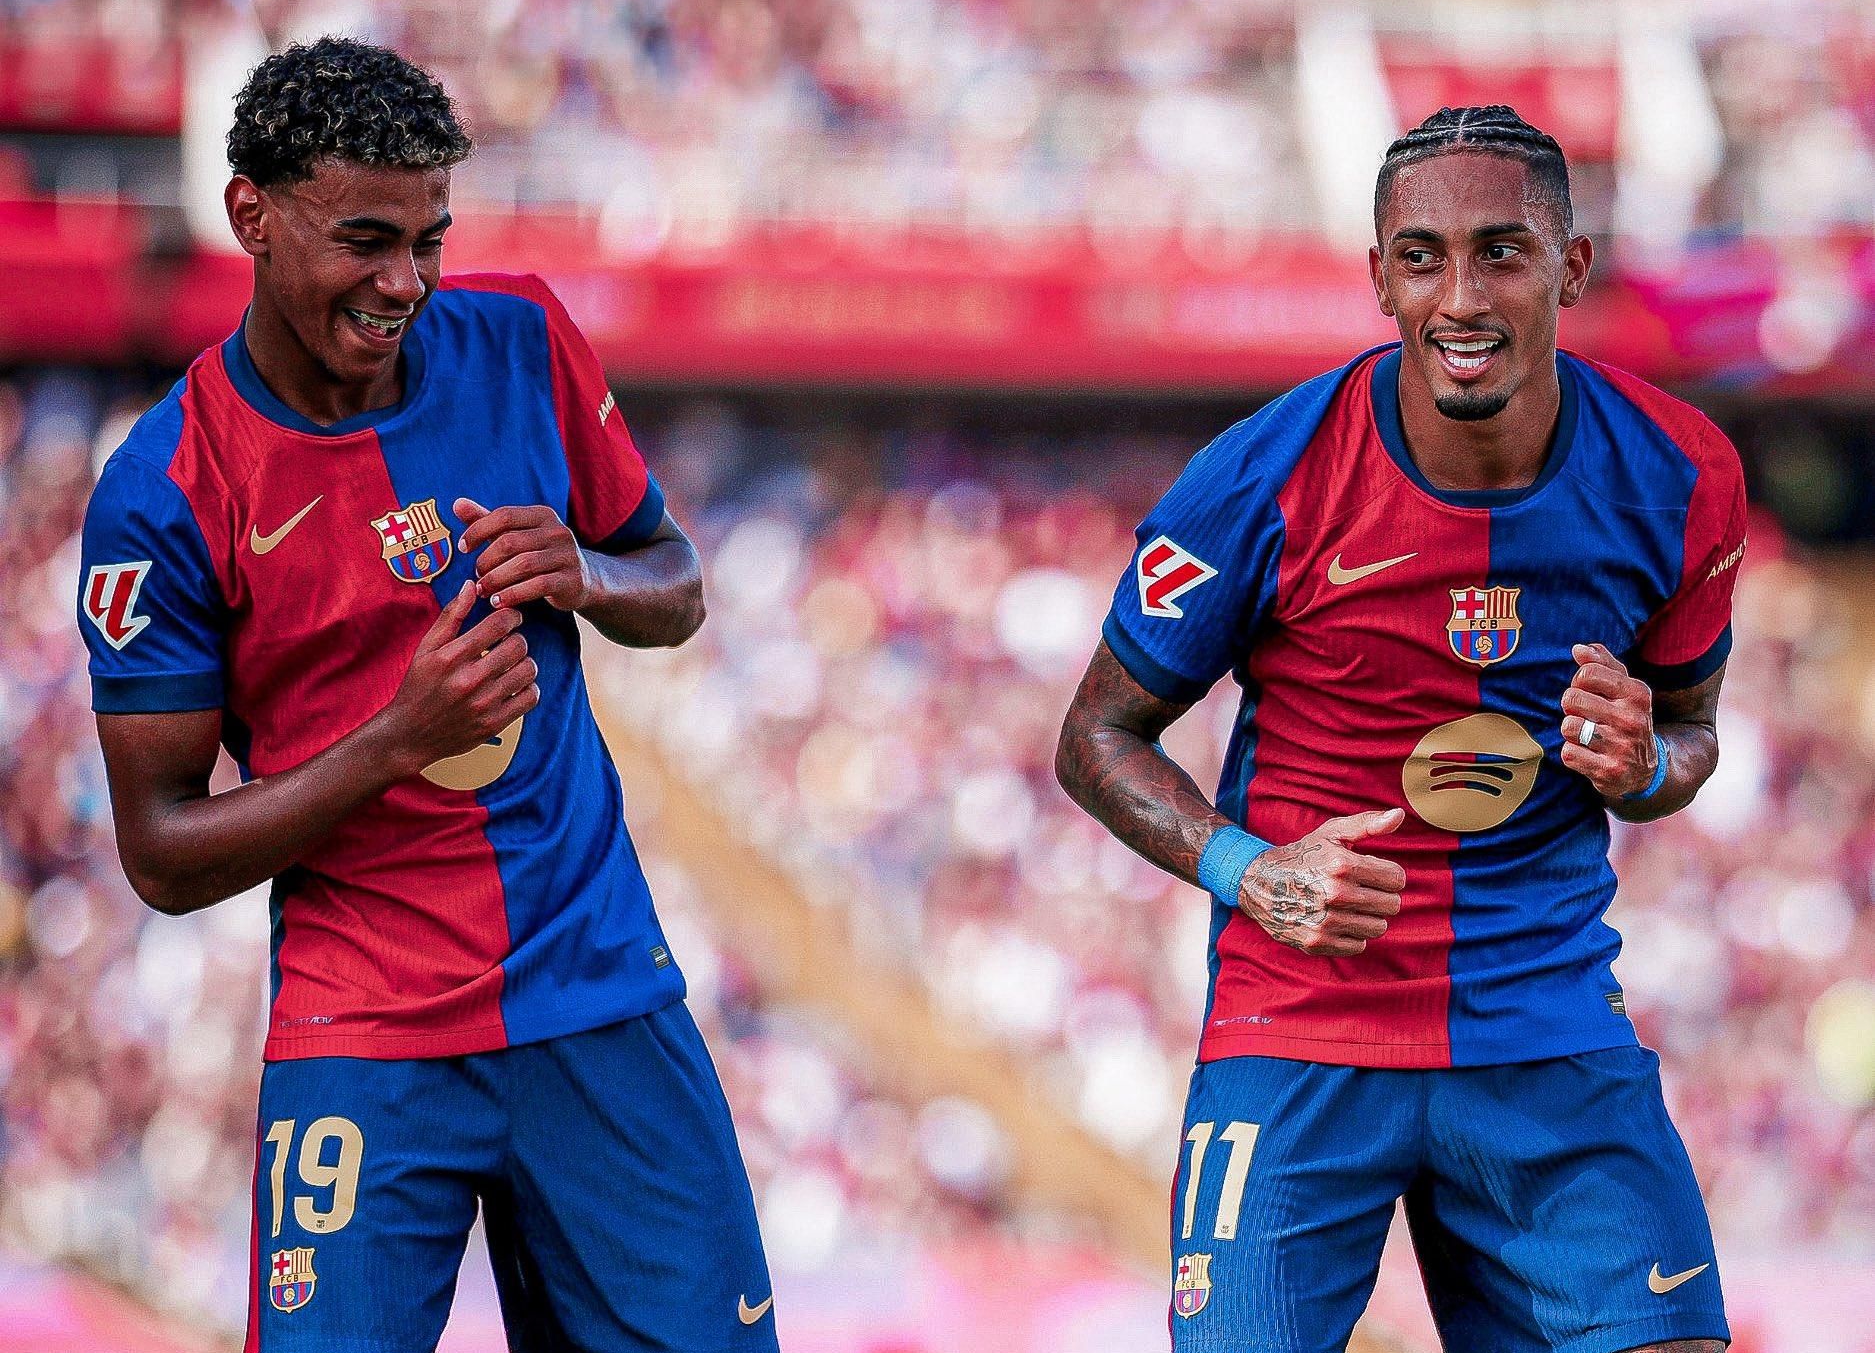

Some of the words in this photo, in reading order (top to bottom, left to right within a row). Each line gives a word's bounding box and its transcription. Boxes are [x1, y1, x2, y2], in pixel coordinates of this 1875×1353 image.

[402, 534, 430, 551] FCB
[1469, 619, 1499, 630] FCB
[265, 1115, 364, 1238] 19
[1181, 1121, 1261, 1240] 11
[280, 1274, 299, 1284] FCB
